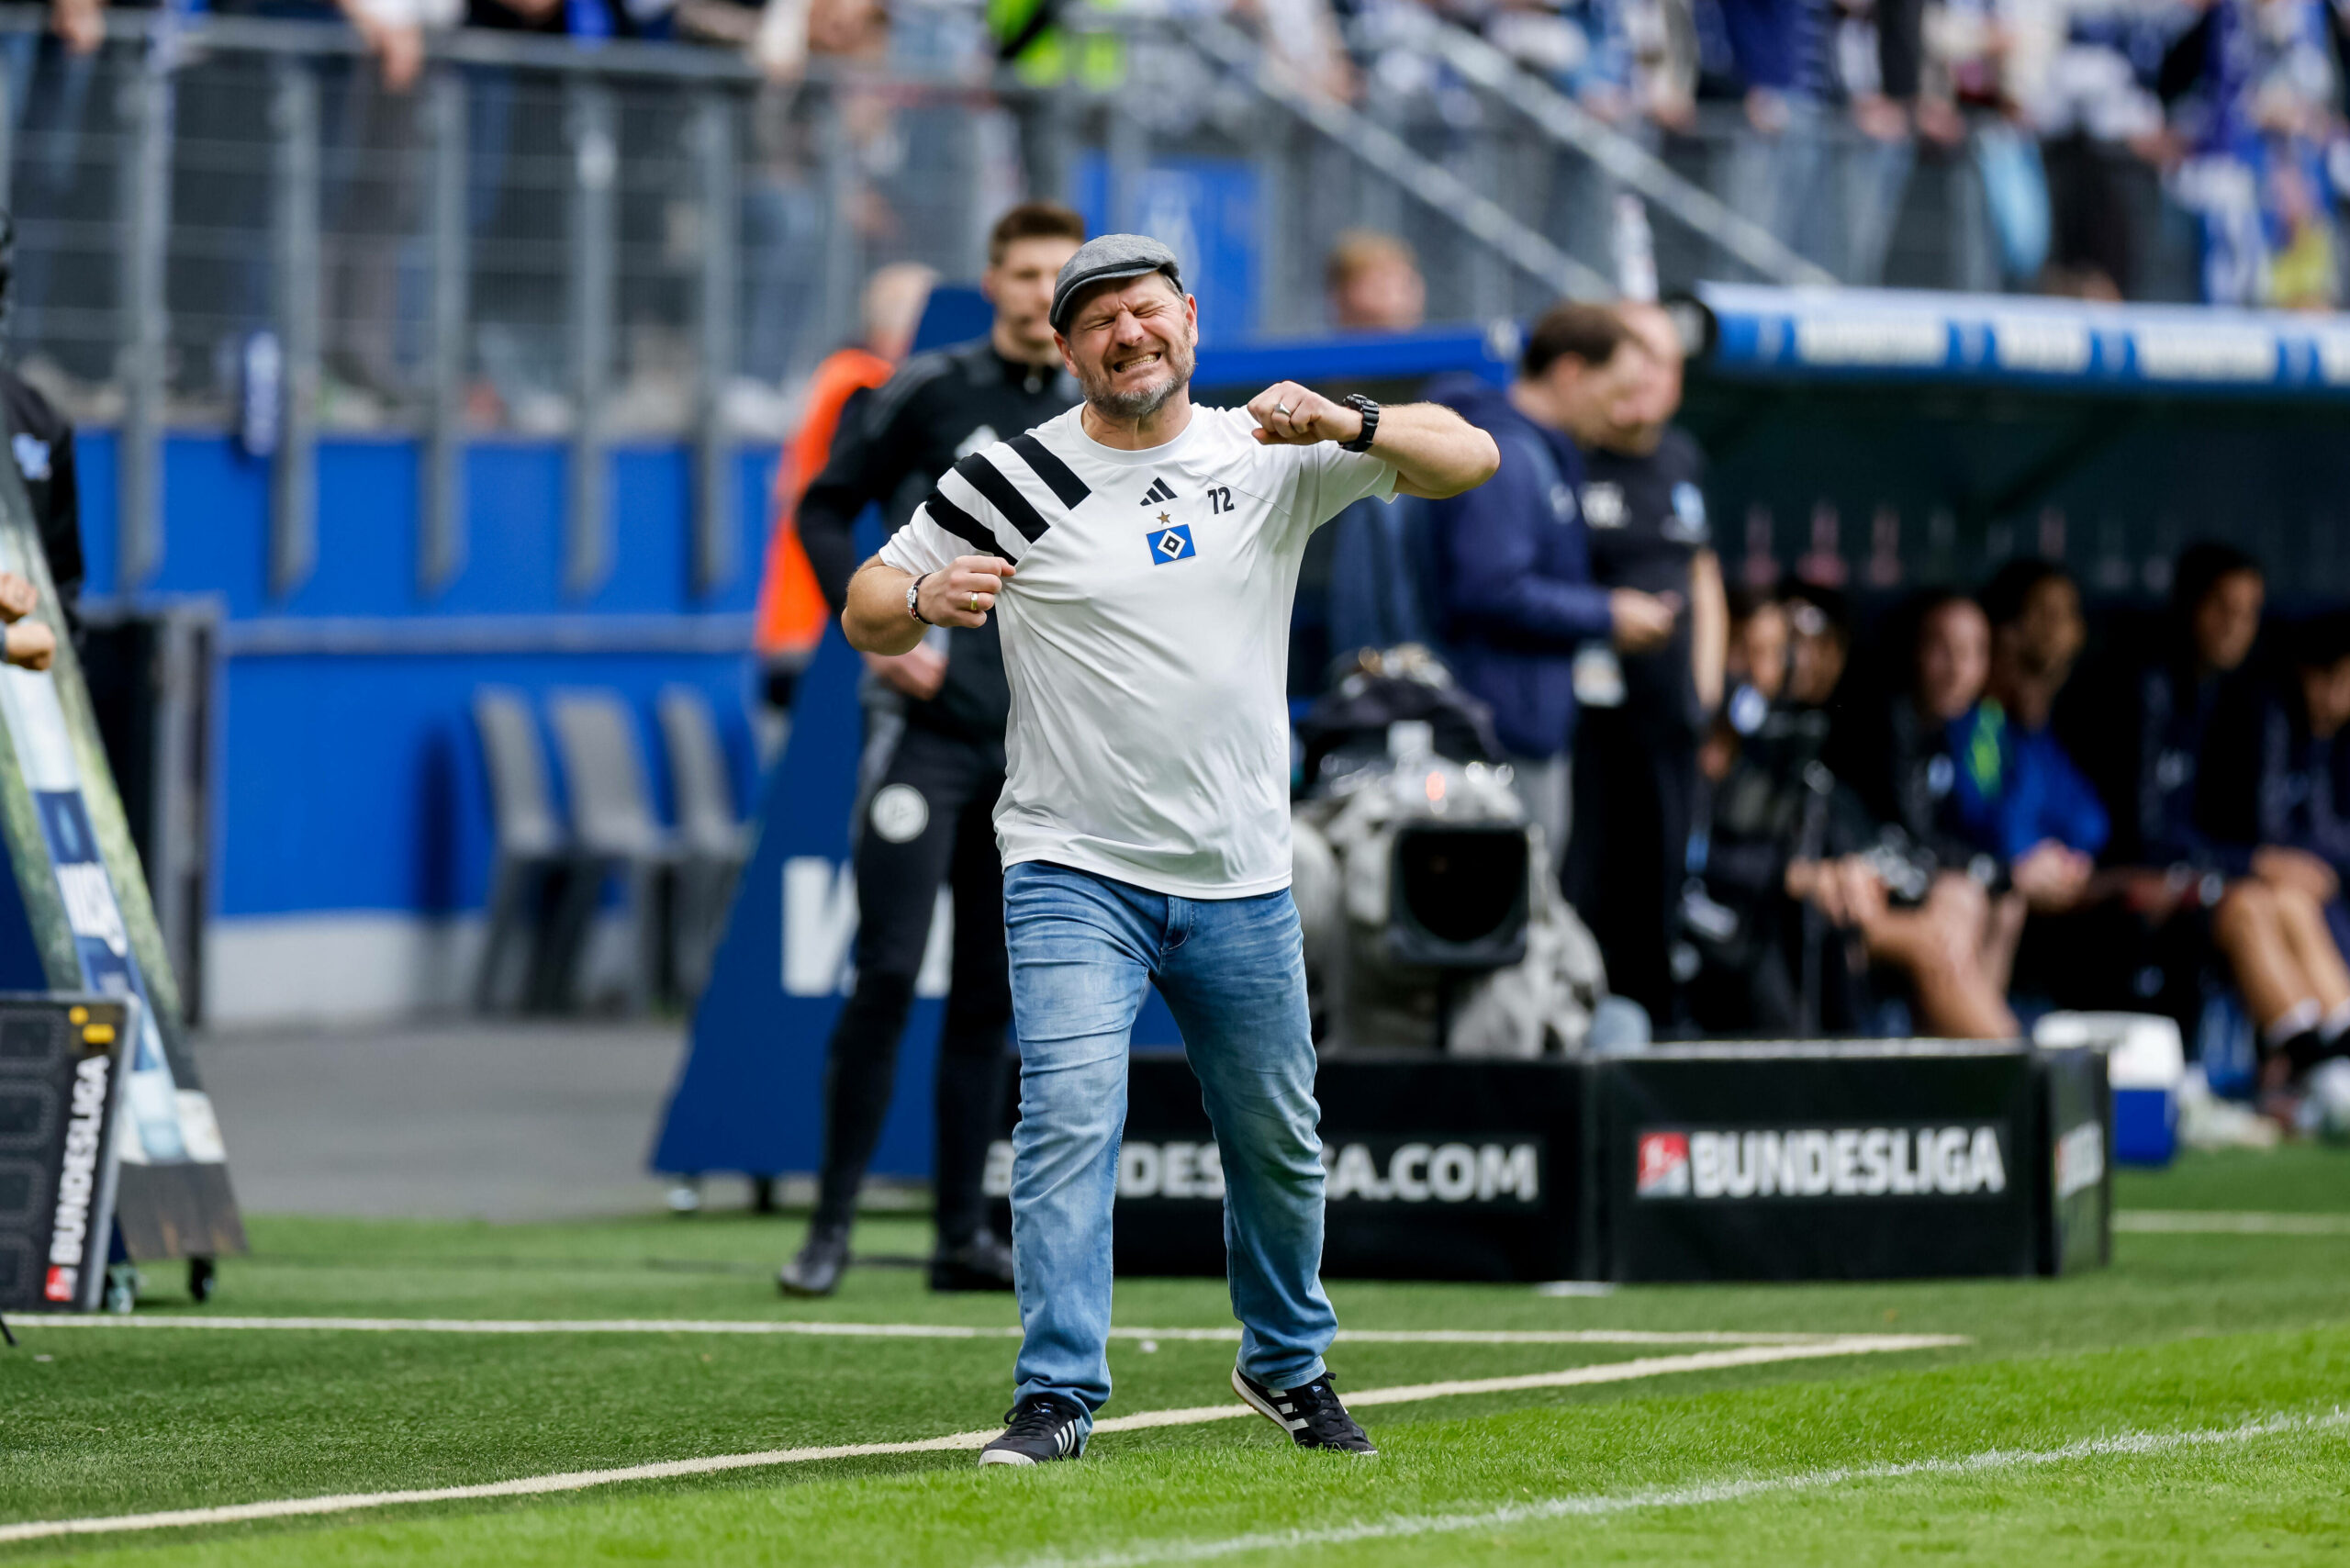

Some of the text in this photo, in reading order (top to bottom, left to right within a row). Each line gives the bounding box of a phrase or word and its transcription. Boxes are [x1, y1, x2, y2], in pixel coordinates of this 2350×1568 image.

[1207, 487, 1235, 515] 72
[49, 1055, 111, 1265] BUNDESLIGA
[981, 1140, 1539, 1202] BDESA.COM
[1691, 1126, 2007, 1198] BUNDESLIGA
